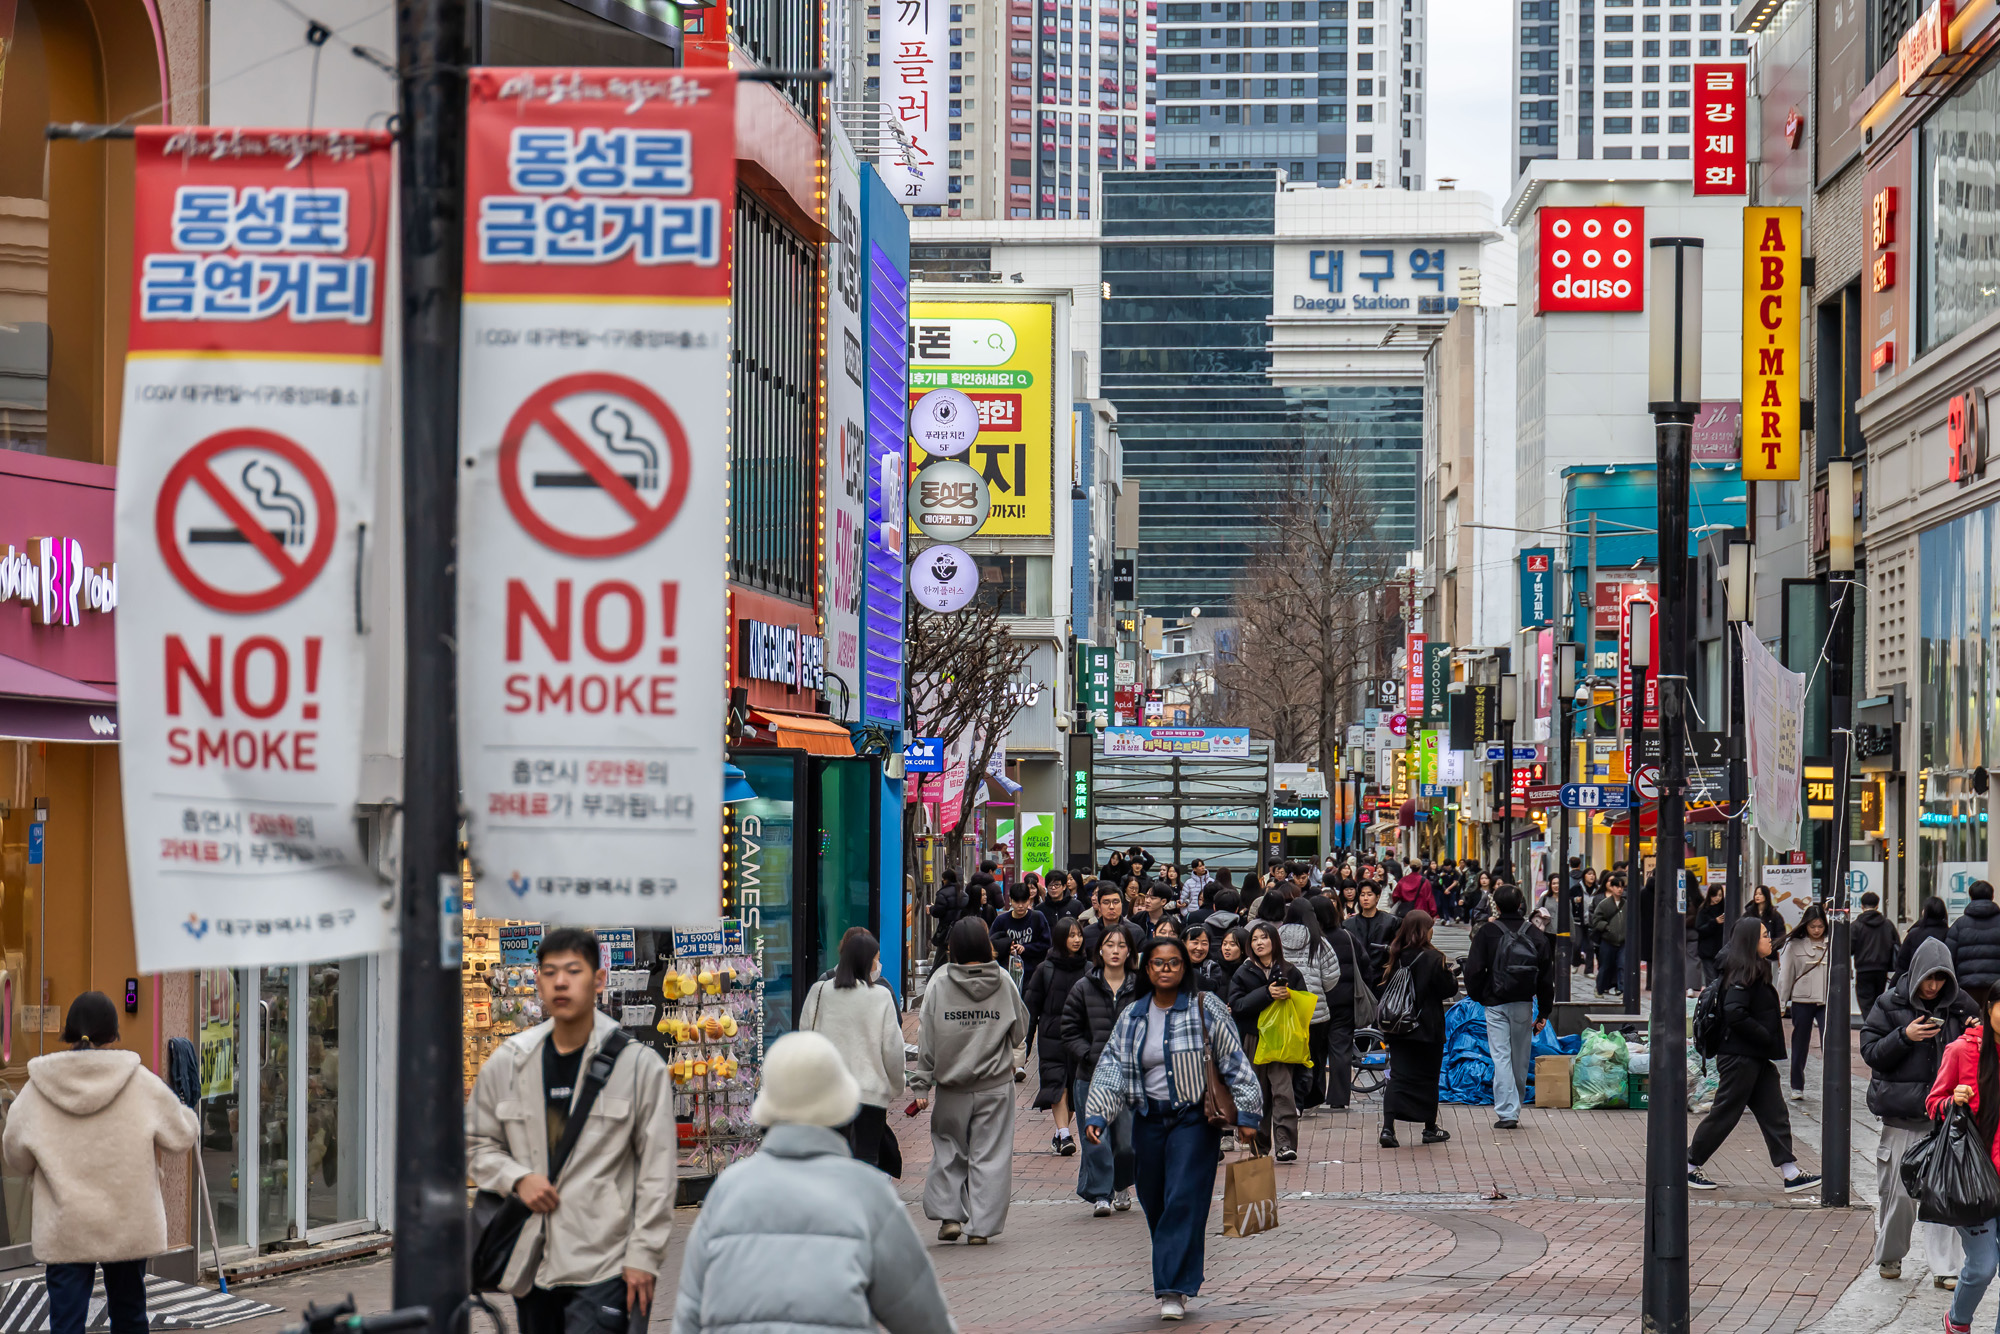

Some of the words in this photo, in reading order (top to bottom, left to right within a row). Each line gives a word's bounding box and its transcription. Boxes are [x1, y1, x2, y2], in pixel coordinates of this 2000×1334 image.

[1705, 72, 1736, 186] 금강제화
[509, 127, 691, 194] 동성로
[905, 184, 922, 196] 2F
[172, 186, 348, 252] 동성로
[479, 196, 720, 267] 금연거리
[1309, 248, 1446, 293] 대구역
[141, 254, 375, 324] 금연거리
[1552, 274, 1631, 299] daiso
[1294, 294, 1346, 313] Daegu
[1353, 294, 1410, 310] Station
[1759, 217, 1786, 470] ABC-MART
[951, 373, 1014, 386] 확인하세요!
[925, 431, 948, 440] 푸라닭
[950, 431, 965, 440] 치킨
[923, 586, 965, 595] 한끼플러스
[1533, 572, 1544, 621] 7번가피자
[506, 577, 679, 665] NO!
[750, 619, 768, 680] KING
[769, 624, 796, 685] GAMES
[1412, 640, 1423, 678] 제이원
[165, 634, 323, 720] NO!
[1431, 647, 1441, 712] CROCODIL
[504, 674, 677, 715] SMOKE
[167, 727, 318, 771] SMOKE
[1143, 738, 1173, 752] 캐릭터
[1174, 740, 1211, 753] 스트리트
[512, 758, 578, 784] 흡연시
[586, 759, 667, 786] 5만원의
[488, 793, 572, 818] 과태료가
[1273, 807, 1299, 817] Grand
[1300, 807, 1322, 819] Ope
[181, 808, 242, 834] 흡연시
[537, 877, 632, 895] 대구광역시
[741, 814, 761, 930] GAMES
[216, 916, 311, 935] 대구광역시
[676, 935, 688, 943] 1개
[690, 932, 720, 943] 5900원
[501, 940, 528, 950] 7900원
[682, 944, 697, 953] 2개
[699, 943, 716, 952] 만원
[944, 1010, 1000, 1020] ESSENTIALS
